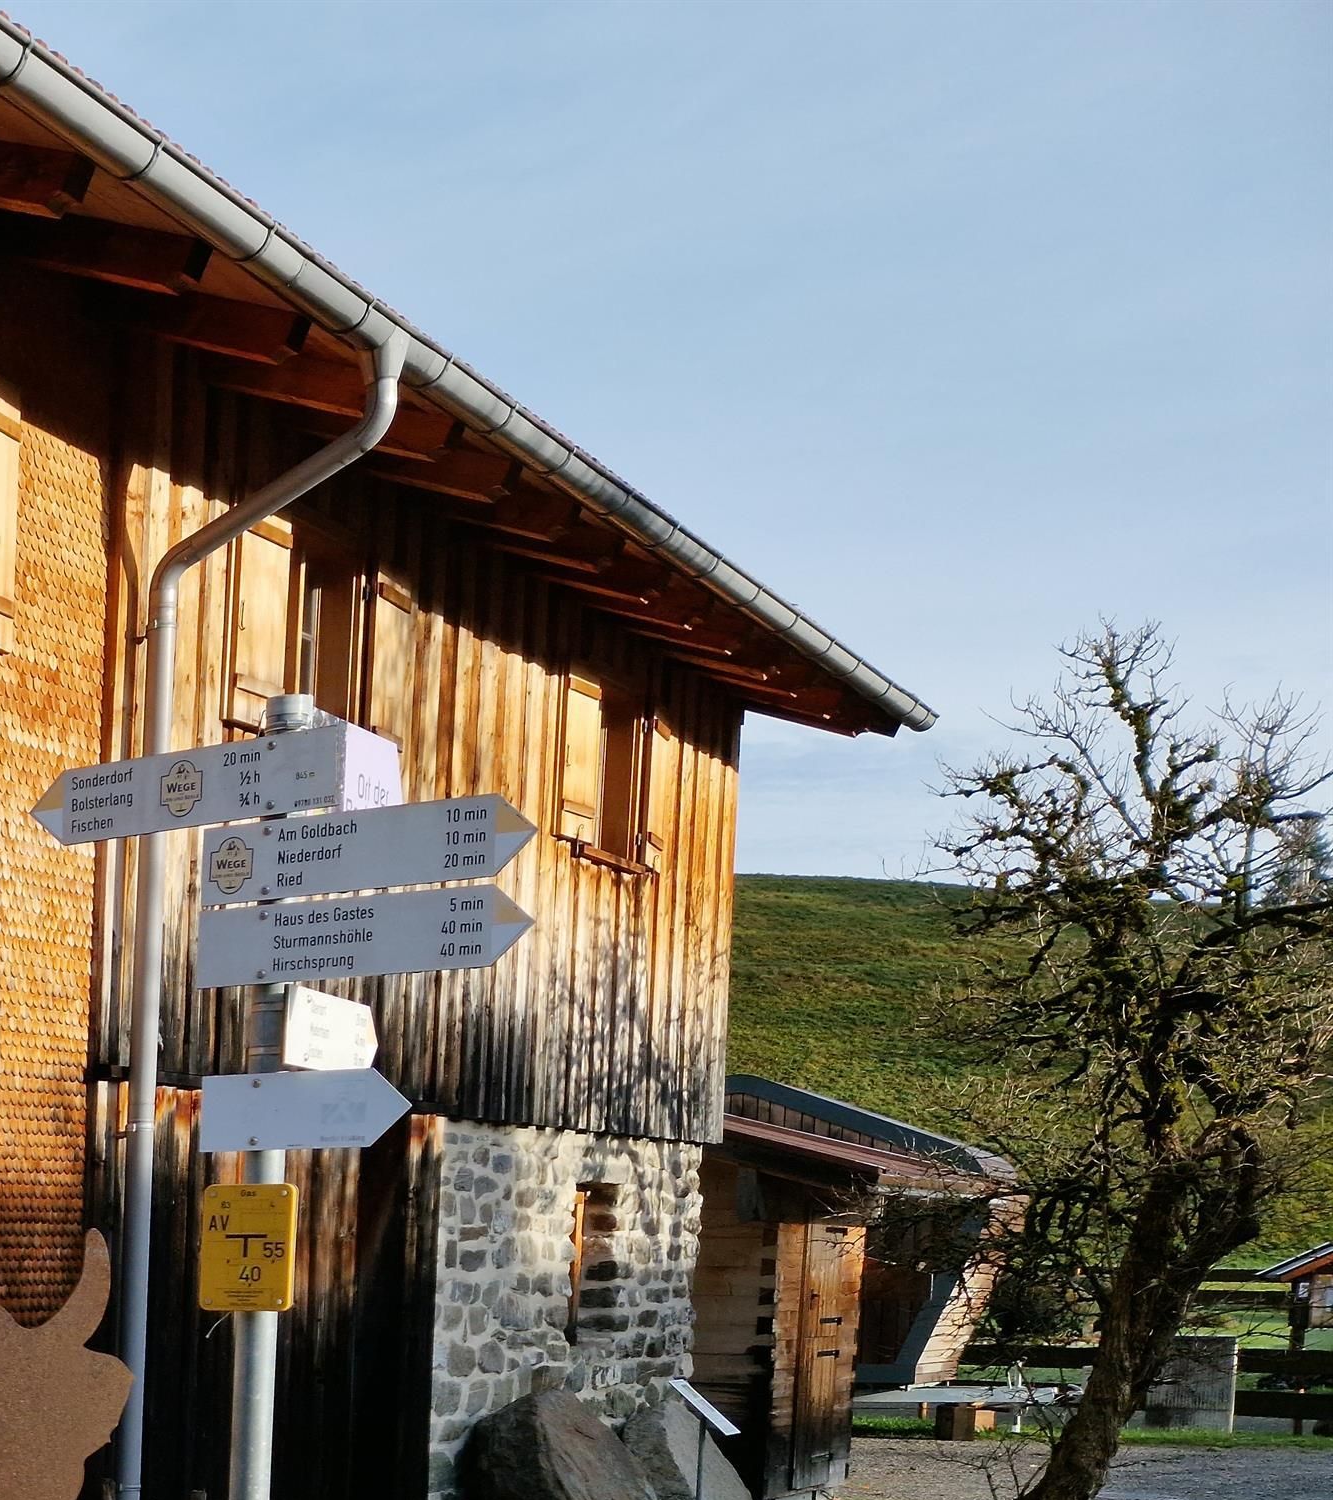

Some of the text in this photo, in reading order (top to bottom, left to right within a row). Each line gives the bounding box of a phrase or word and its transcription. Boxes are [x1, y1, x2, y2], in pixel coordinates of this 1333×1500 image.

[71, 751, 261, 791] Sonderdorf 20 min
[295, 771, 307, 780] 845
[358, 773, 371, 801] Ort
[71, 793, 133, 814] Bolsterlang
[253, 770, 260, 783] h
[71, 817, 113, 833] Fischen
[253, 792, 260, 805] h
[278, 807, 487, 842] Am Goldbach 10 min
[277, 830, 486, 865] Niederdorf 10 min
[276, 852, 485, 888] Ried 20 min
[275, 896, 484, 927] Haus des Gastes 5 min
[273, 919, 483, 950] Sturmannshöhle 40 min
[272, 942, 481, 973] Hirschsprung 40 min
